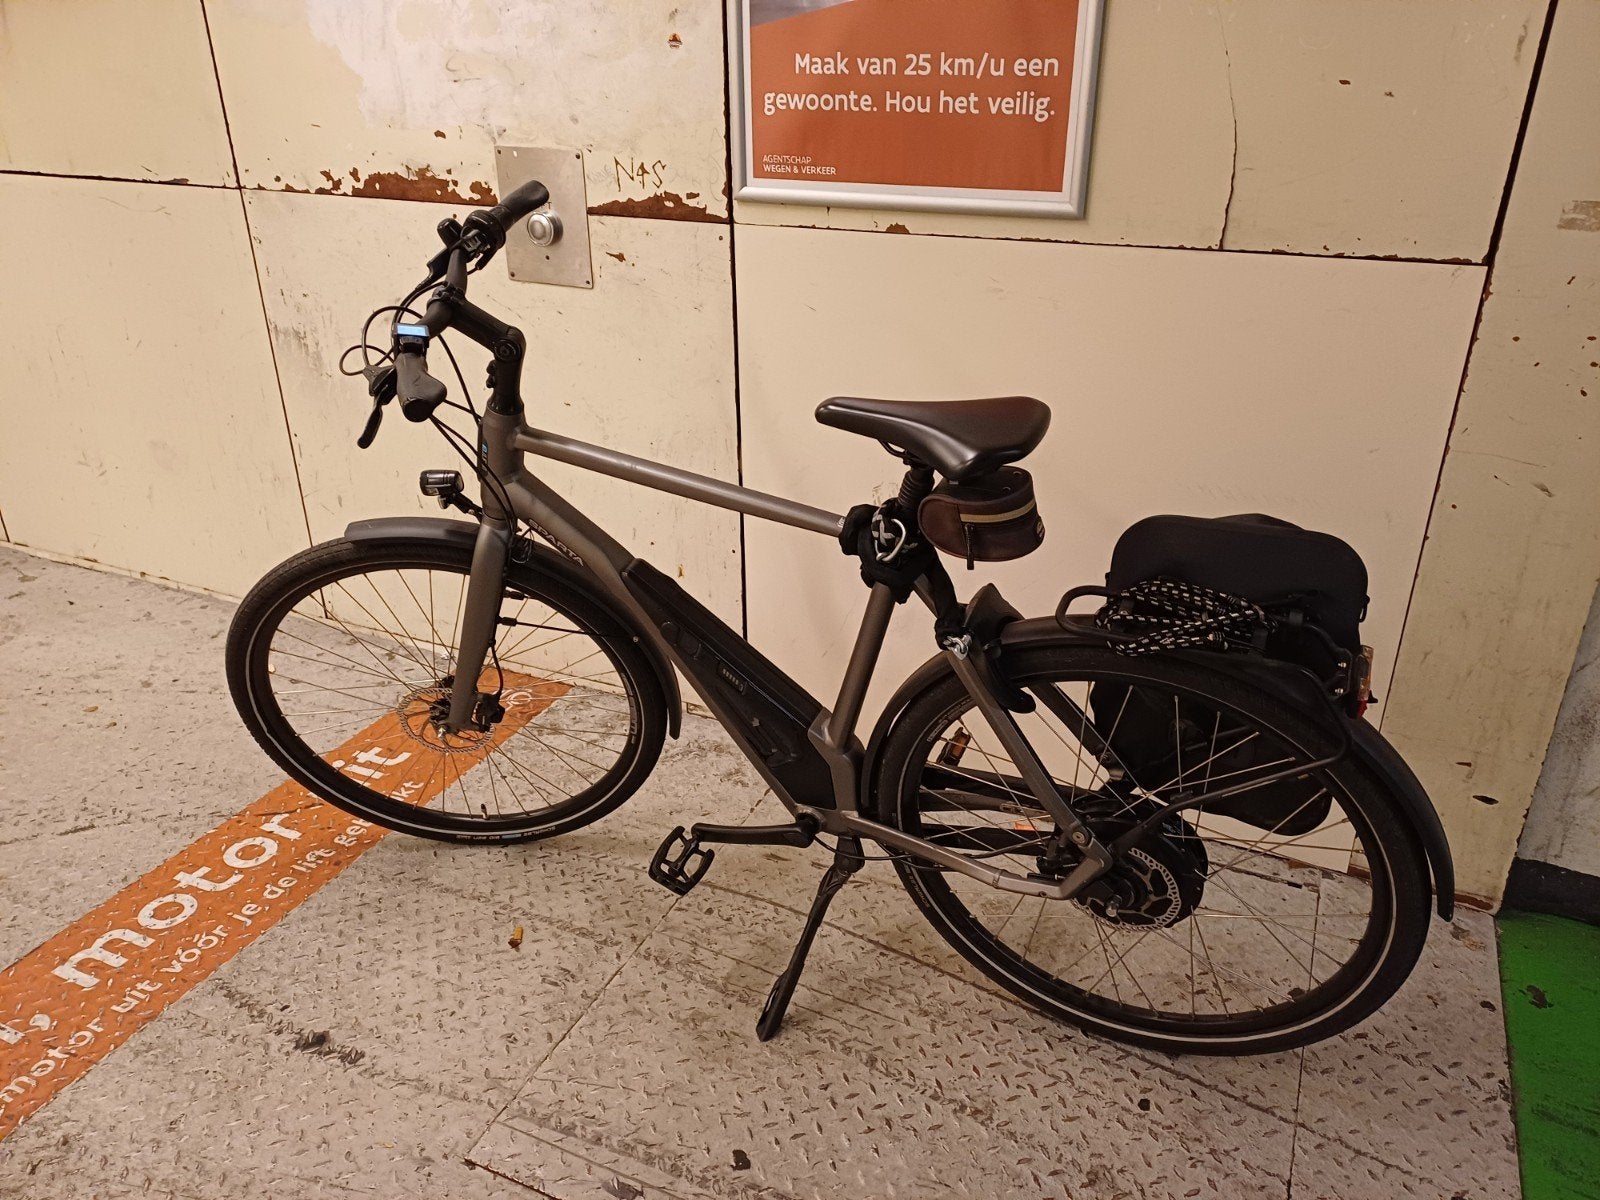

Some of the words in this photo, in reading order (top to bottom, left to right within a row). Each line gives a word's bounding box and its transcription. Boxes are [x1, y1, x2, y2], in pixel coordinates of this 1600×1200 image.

[795, 51, 849, 76] Maak
[857, 57, 896, 76] van
[904, 53, 931, 76] 25
[940, 52, 1004, 79] km/u
[1013, 57, 1059, 77] een
[763, 90, 877, 116] gewoonte.
[885, 91, 930, 114] Hou
[939, 90, 979, 115] het
[988, 91, 1055, 122] veilig.
[763, 154, 812, 165] AGENTSCHAP
[763, 164, 791, 173] WEGEN
[793, 165, 799, 174] &
[801, 165, 836, 175] VERKEER
[528, 518, 584, 568] SPARTA
[50, 813, 302, 988] motor
[111, 979, 163, 1013] uit
[226, 902, 262, 926] je
[263, 877, 298, 900] de
[291, 847, 336, 873] lift
[333, 781, 424, 847] gebikt
